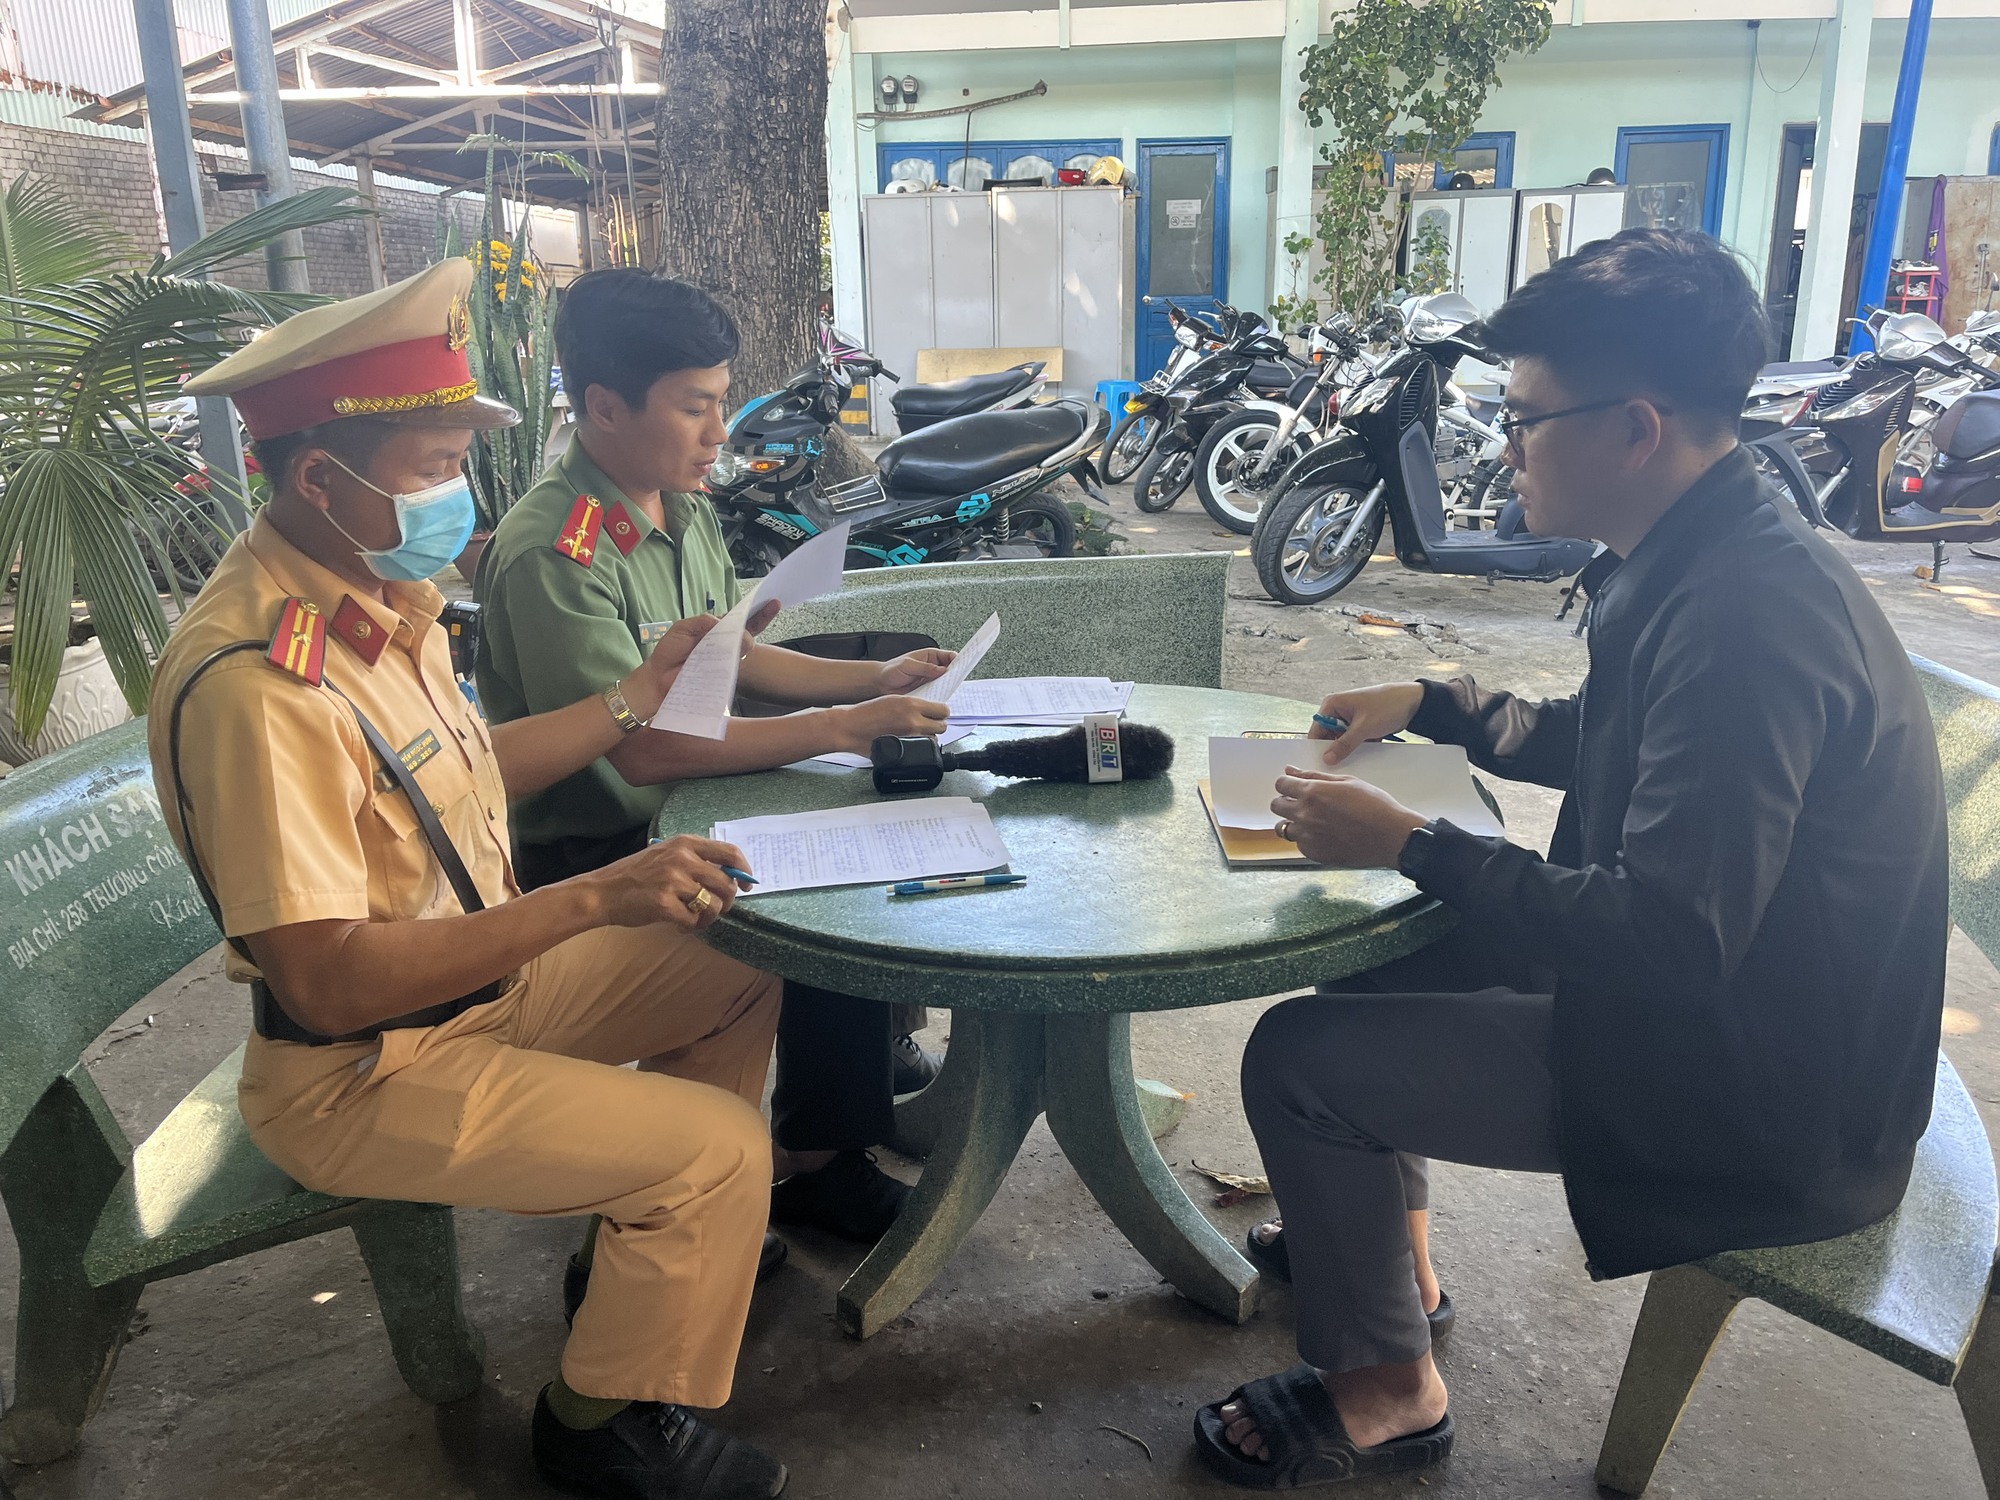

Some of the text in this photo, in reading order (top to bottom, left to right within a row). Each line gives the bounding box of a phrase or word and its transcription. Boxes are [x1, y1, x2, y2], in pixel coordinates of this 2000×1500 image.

[754, 517, 802, 540] SPEED
[1100, 728, 1118, 768] BRT
[4, 812, 112, 897] KHÁCH
[60, 900, 89, 932] 258
[145, 843, 182, 876] CÔN
